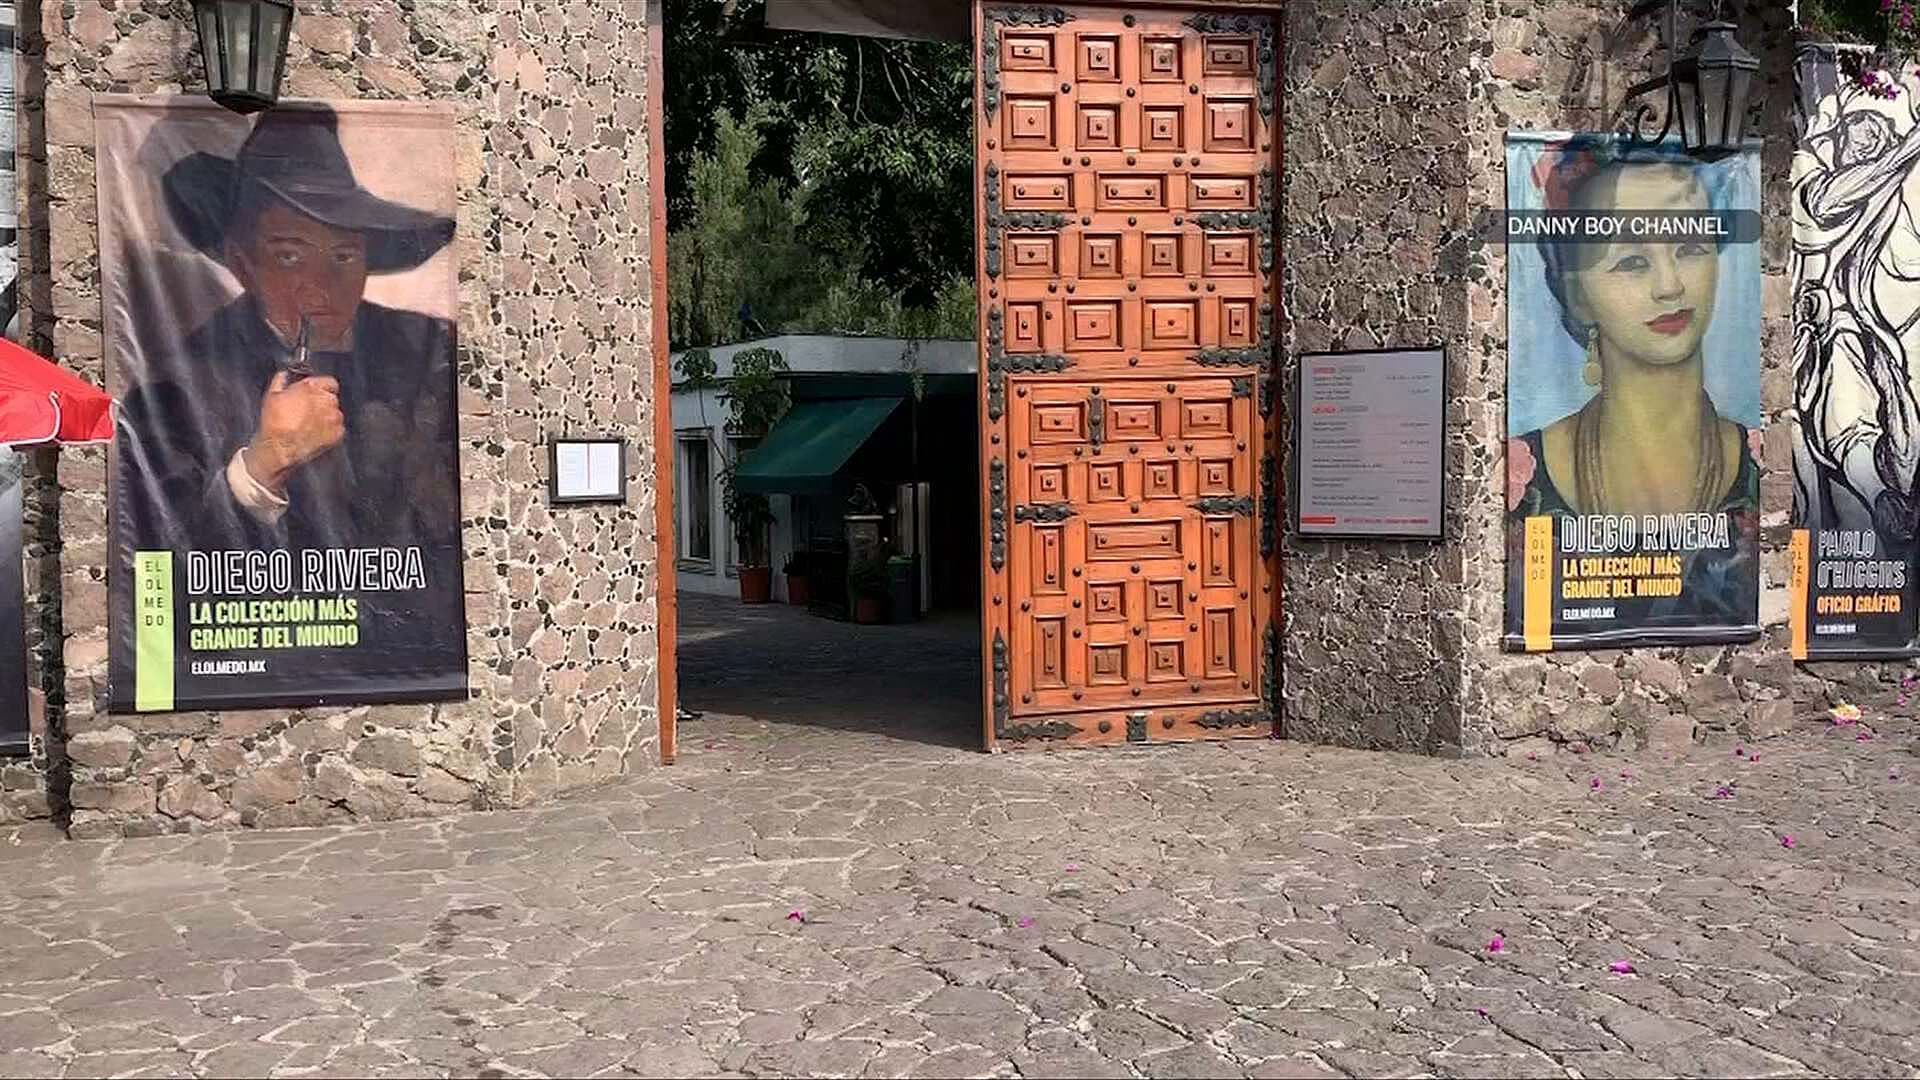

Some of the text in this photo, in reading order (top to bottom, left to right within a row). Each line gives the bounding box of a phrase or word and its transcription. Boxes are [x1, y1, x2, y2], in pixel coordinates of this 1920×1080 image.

[1561, 512, 1730, 552] DIEGO RIVERA
[1818, 529, 1877, 558] PABLO
[187, 547, 426, 595] DIEGO RIVERA
[1562, 552, 1682, 577] LA COLECCIÓN MÁS
[1562, 577, 1683, 599] GRANDE DEL MUNDO
[190, 594, 358, 625] LA COLECCIÓN MÁS
[1817, 595, 1853, 614] OFICIO
[190, 624, 359, 650] GRANDE DEL MUNDO
[191, 660, 267, 675] ELOLMEDO.MX
